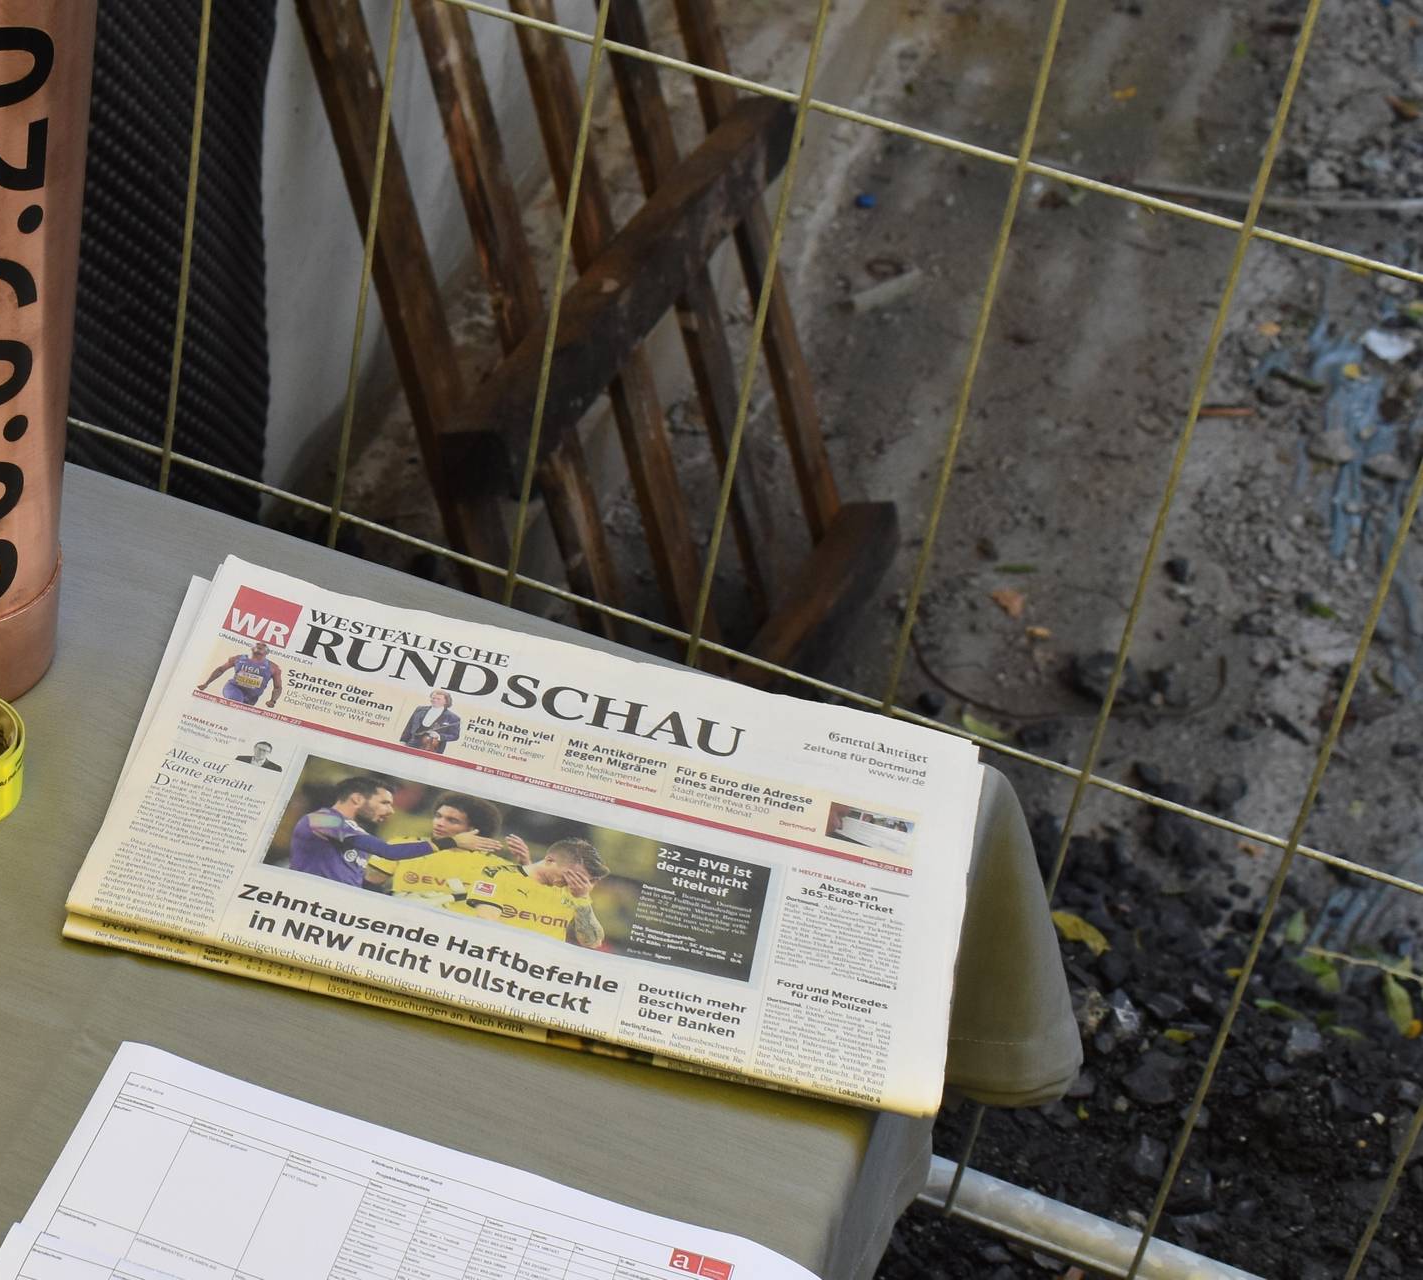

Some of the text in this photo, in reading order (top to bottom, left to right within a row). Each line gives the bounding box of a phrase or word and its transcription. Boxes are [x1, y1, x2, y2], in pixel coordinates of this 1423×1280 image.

[230, 608, 291, 649] WR
[309, 608, 511, 668] WESTFÄLISCHE
[287, 678, 394, 712] Sprinter Coleman
[288, 669, 375, 698] Schatten über
[296, 623, 746, 757] RUNDSCHAU
[284, 696, 331, 714] Dopingtests
[348, 713, 364, 723] WM
[286, 689, 334, 707] US-Sportler
[335, 702, 374, 719] verpasste
[467, 723, 494, 737] Frau
[497, 731, 509, 741] in
[498, 721, 529, 736] habe
[532, 731, 555, 742] viel
[165, 748, 230, 774] Alles auf
[564, 749, 658, 776] gegen Migräne
[568, 738, 668, 769] Mit Antikörpern
[803, 743, 927, 778] Zeitung für Dortmund
[161, 759, 256, 793] Kante genäht
[676, 766, 813, 805] Für 6 Euro die Adresse
[674, 776, 805, 813] eines anderen finden
[656, 861, 749, 890] derzeit nicht
[657, 848, 753, 879] 2:2 BVB ist
[672, 876, 730, 898] titelreif
[800, 887, 894, 915] 365-Euro-Ticket
[819, 882, 878, 902] Absage an
[237, 883, 441, 948] Zehntausende
[447, 934, 620, 994] Haftbefehle
[248, 909, 278, 933] in
[282, 917, 354, 952] NRW
[358, 940, 432, 976] nicht
[438, 960, 593, 1015] vollstreckt
[220, 932, 334, 970] Polizeigewerkschaft
[365, 969, 423, 992] Benötigen
[528, 1010, 547, 1024] die
[638, 983, 747, 1014] Deutlich mehr
[777, 978, 888, 1010] Ford und Mercedes
[790, 989, 872, 1014] für die Polizei
[468, 1014, 495, 1028] Nach
[638, 995, 741, 1025] Beschwerden
[638, 1007, 735, 1038] über Banken
